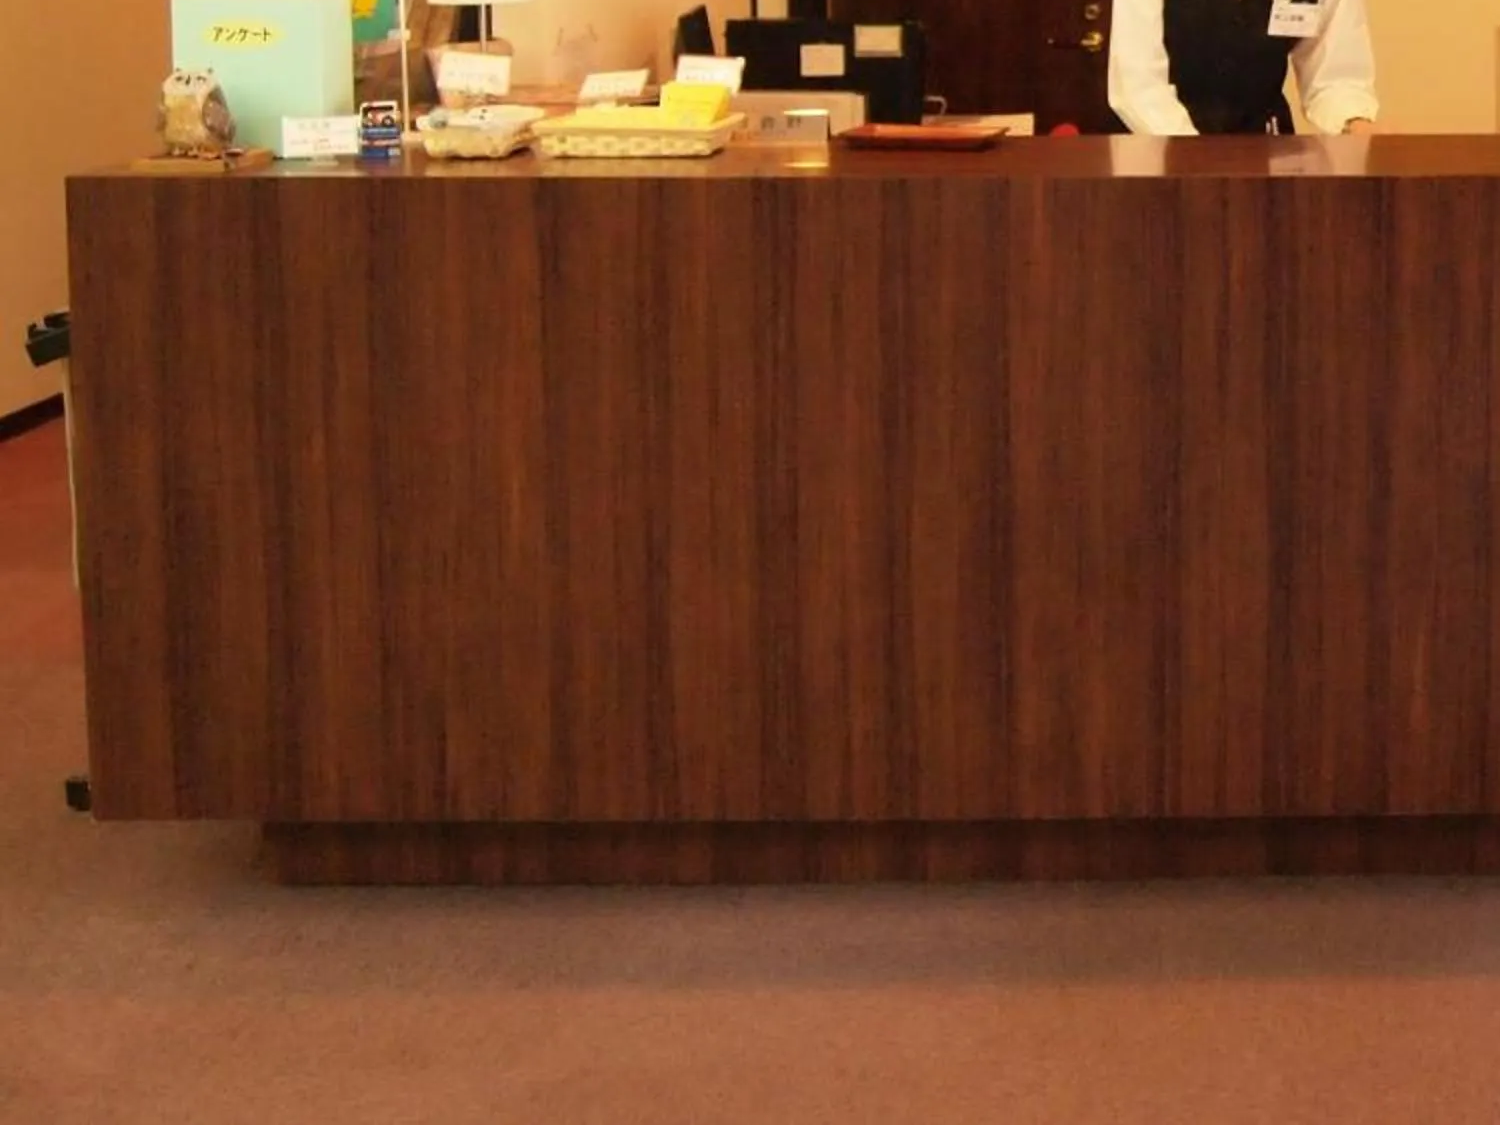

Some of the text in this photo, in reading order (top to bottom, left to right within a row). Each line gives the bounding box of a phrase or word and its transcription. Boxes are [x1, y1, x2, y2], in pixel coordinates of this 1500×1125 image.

[213, 27, 271, 42] アンケート
